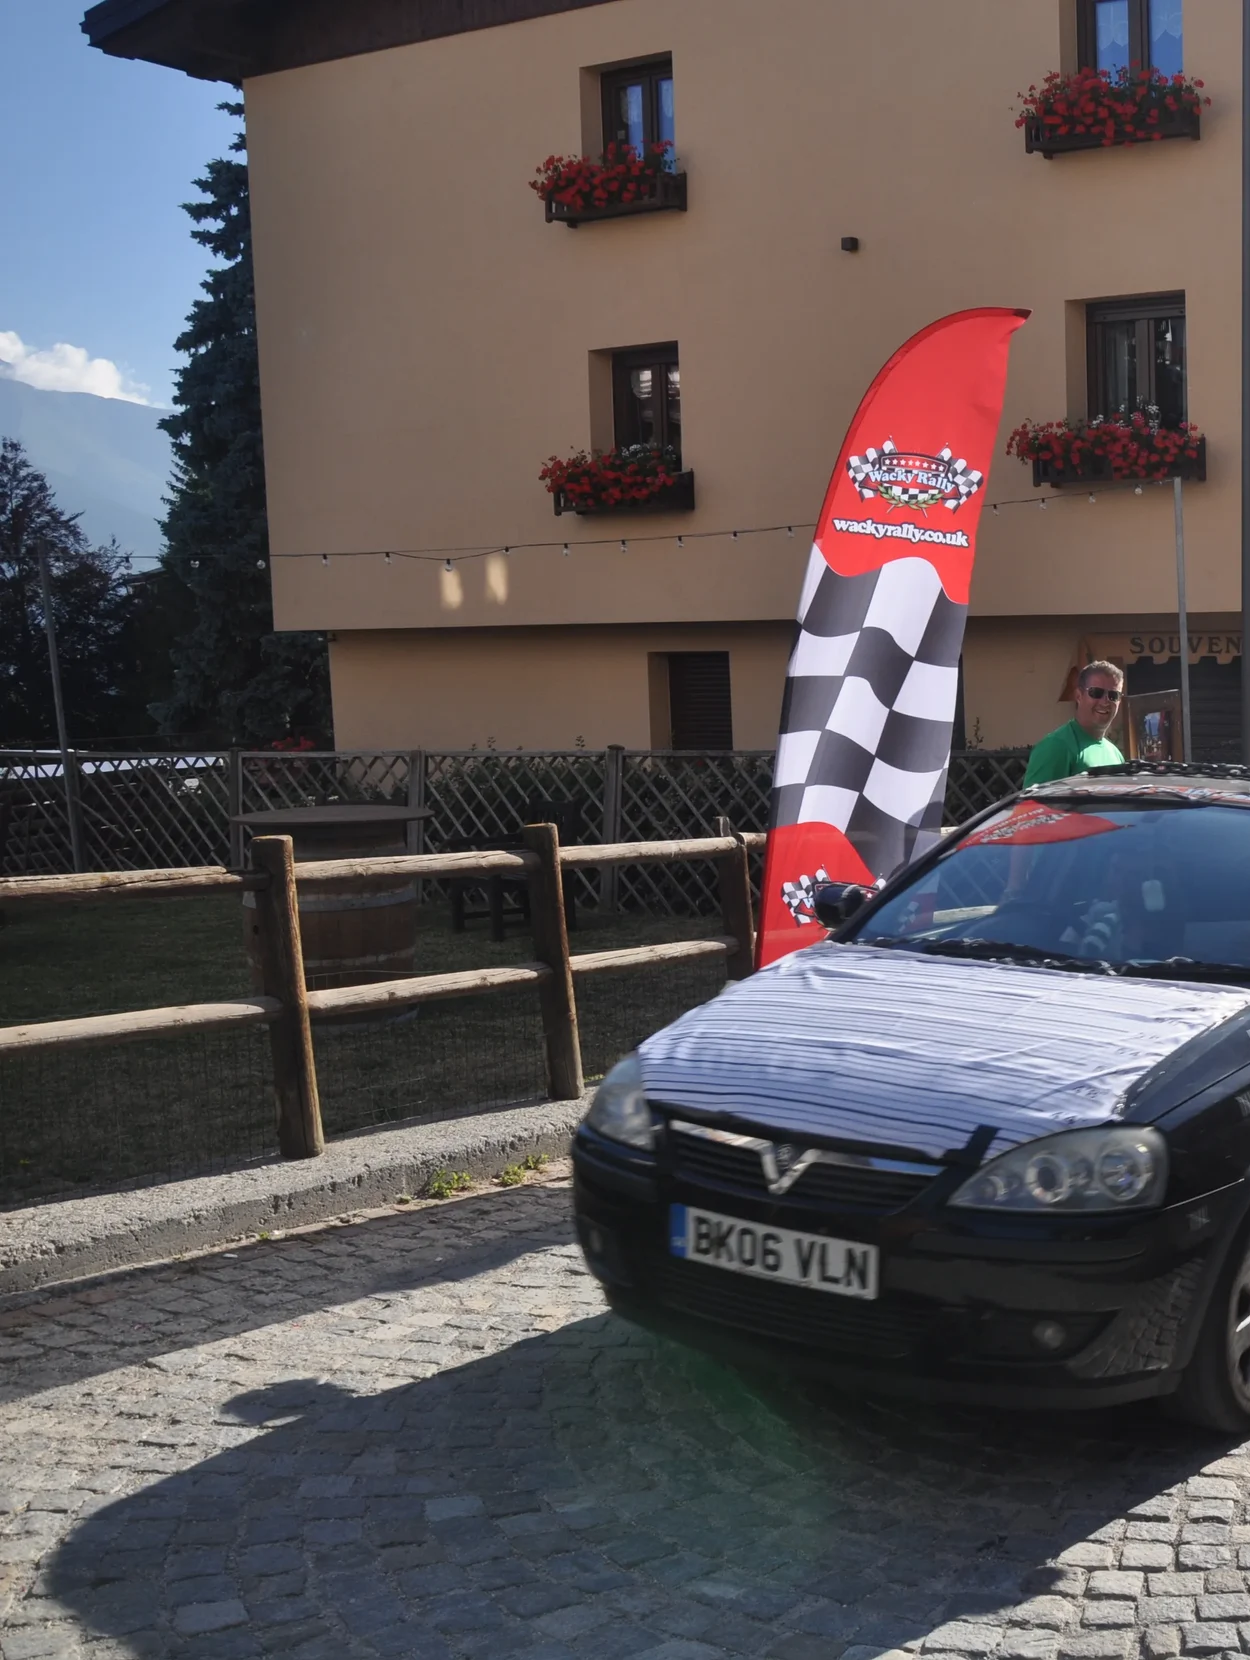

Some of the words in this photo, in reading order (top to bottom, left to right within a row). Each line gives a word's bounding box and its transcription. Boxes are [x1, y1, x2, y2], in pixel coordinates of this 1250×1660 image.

[868, 467, 914, 484] Wacky
[917, 473, 955, 492] Rally
[833, 518, 969, 547] wackyrally.co.uk
[694, 1216, 783, 1271] BK06
[794, 1238, 869, 1289] VLN
